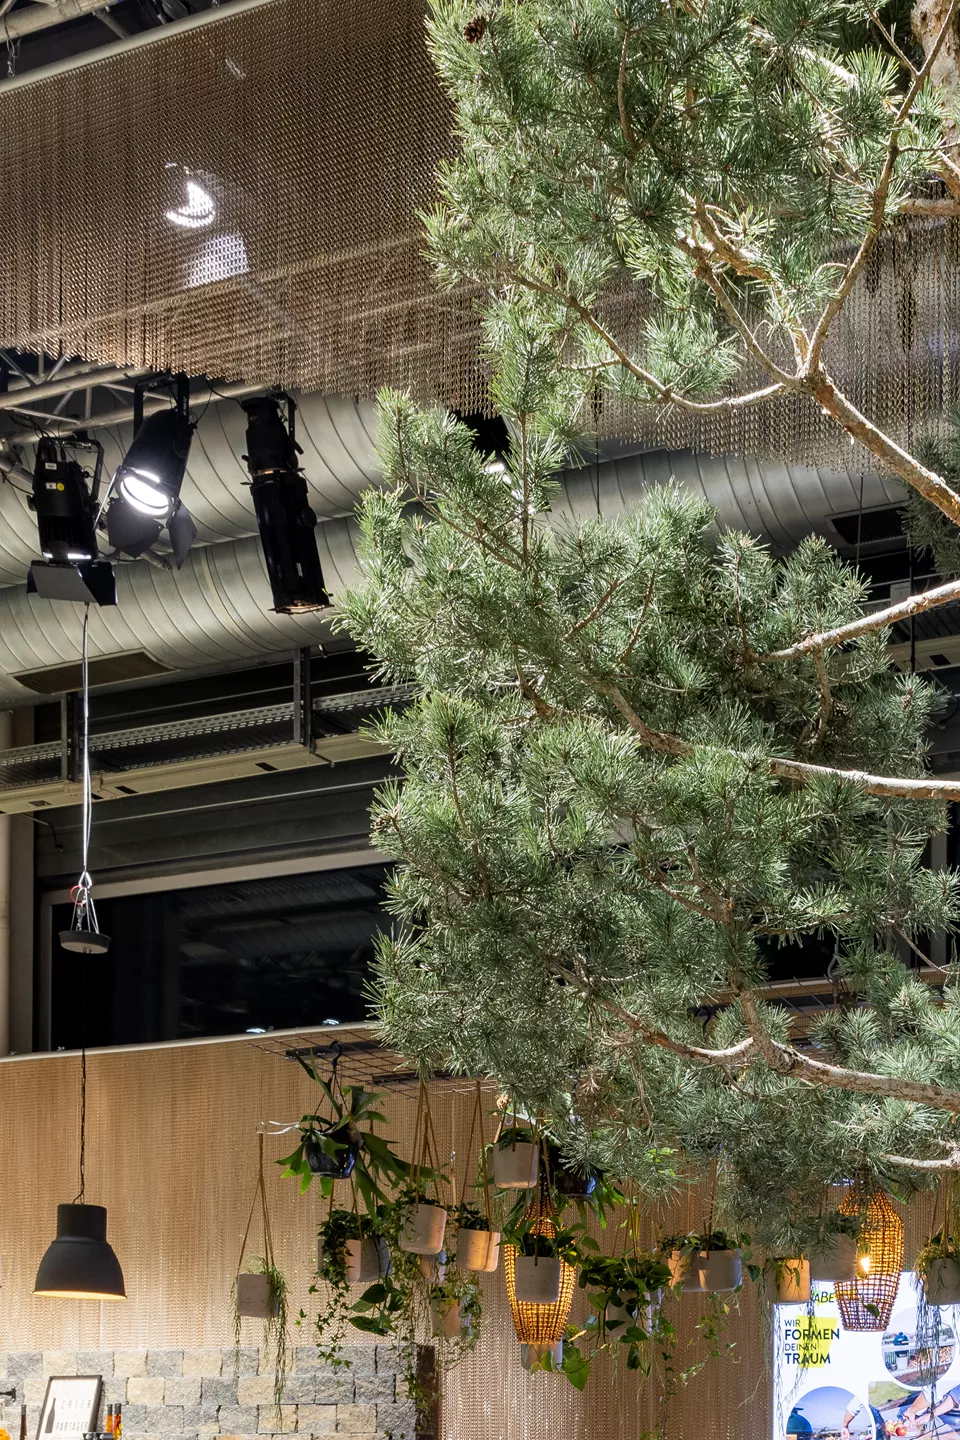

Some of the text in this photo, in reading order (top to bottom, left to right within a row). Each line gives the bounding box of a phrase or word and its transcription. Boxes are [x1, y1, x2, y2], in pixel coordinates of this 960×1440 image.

[784, 1319, 801, 1327] WIR
[784, 1328, 840, 1340] FORMEN
[784, 1343, 817, 1352] DEINEN
[784, 1352, 831, 1365] TRAUM
[55, 1421, 89, 1431] PARTAGER
